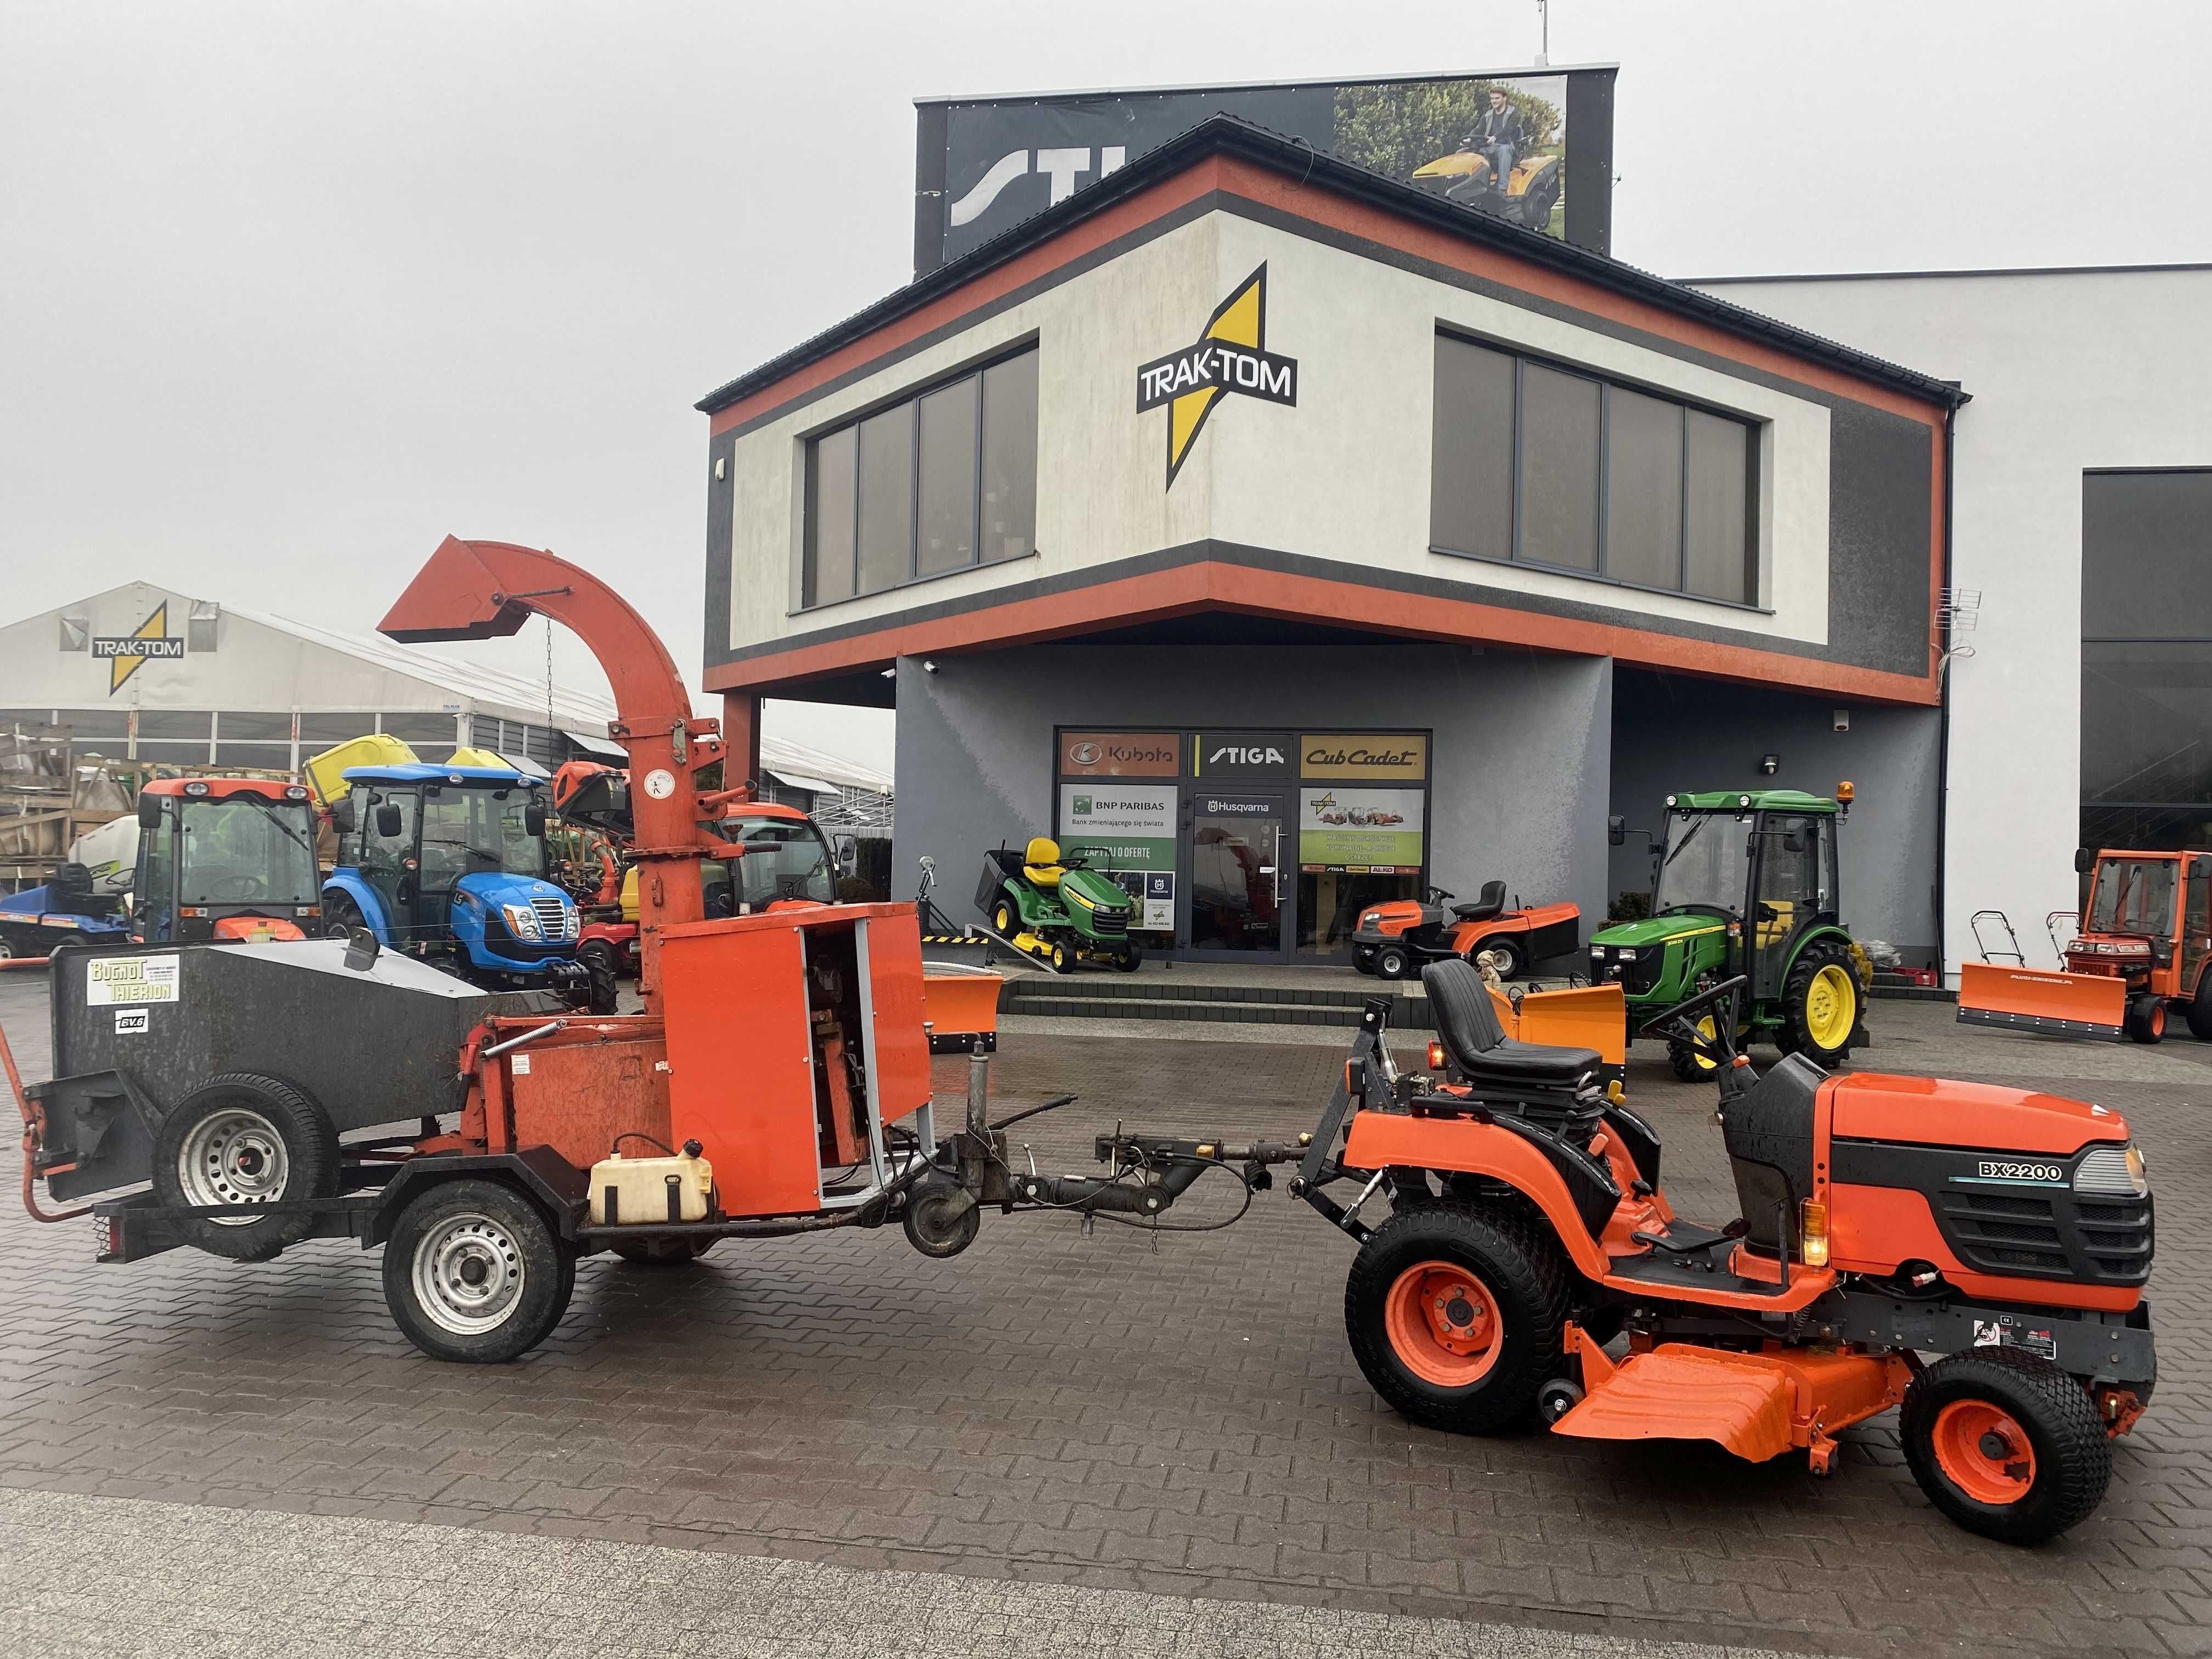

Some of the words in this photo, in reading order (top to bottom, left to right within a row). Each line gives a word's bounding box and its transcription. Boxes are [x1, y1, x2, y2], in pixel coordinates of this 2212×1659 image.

[1141, 347, 1291, 401] TRAK-TOM
[94, 641, 180, 655] TRAK-TOM
[1109, 746, 1173, 762] Kubota
[1210, 747, 1284, 764] STIGA
[1306, 749, 1346, 765] Cub
[1347, 749, 1418, 766] Cadet
[1096, 802, 1118, 810] BNP
[1120, 802, 1165, 810] PARIBAS
[1218, 802, 1269, 812] Husqvarna
[1088, 819, 1132, 827] zmieniającego
[1118, 847, 1122, 857] O
[1124, 848, 1150, 859] OFERTĘ
[1979, 1161, 2062, 1181] BX2200
